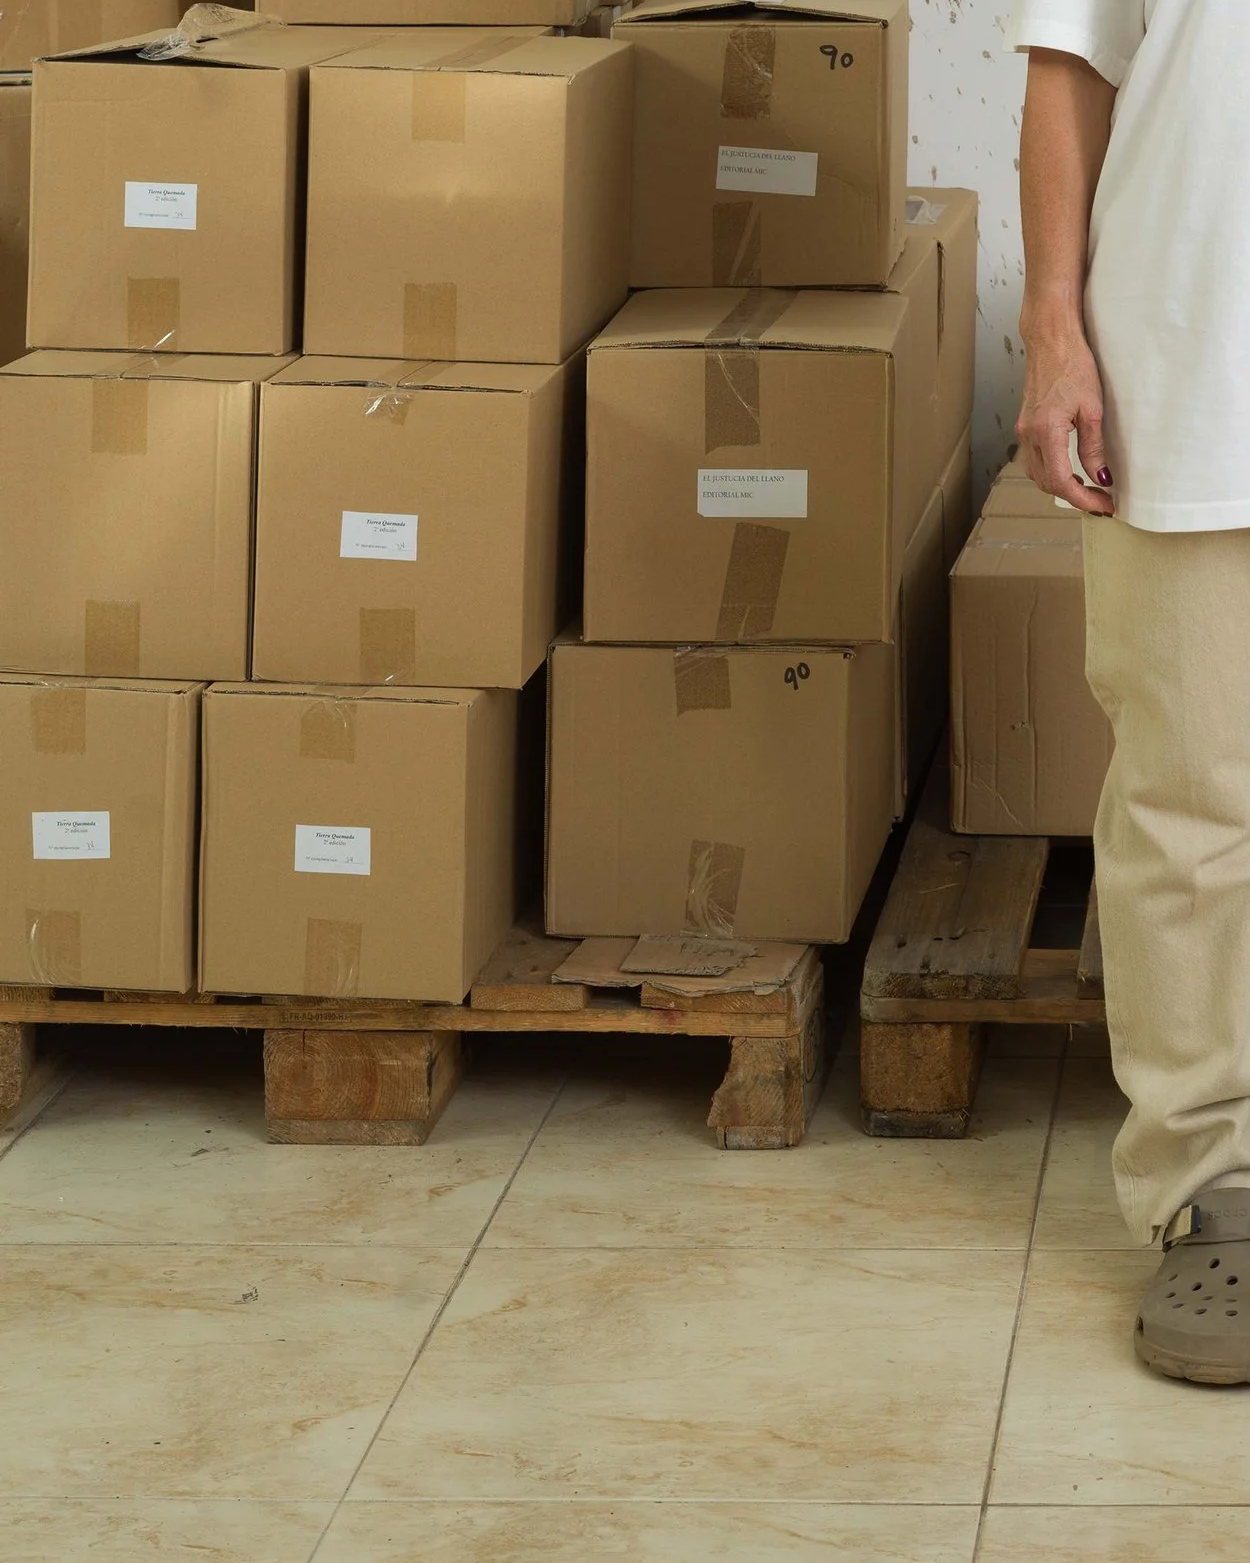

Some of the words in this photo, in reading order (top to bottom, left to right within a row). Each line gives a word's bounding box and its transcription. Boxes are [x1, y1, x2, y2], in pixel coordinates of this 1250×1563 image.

[819, 44, 854, 71] 90
[761, 152, 773, 160] DEL
[774, 154, 796, 162] LLANO
[720, 165, 753, 174] EDITORIAL
[746, 475, 760, 483] DEL
[761, 475, 785, 483] LLANO
[702, 491, 740, 499] EDITORIAL
[784, 662, 811, 691] 90
